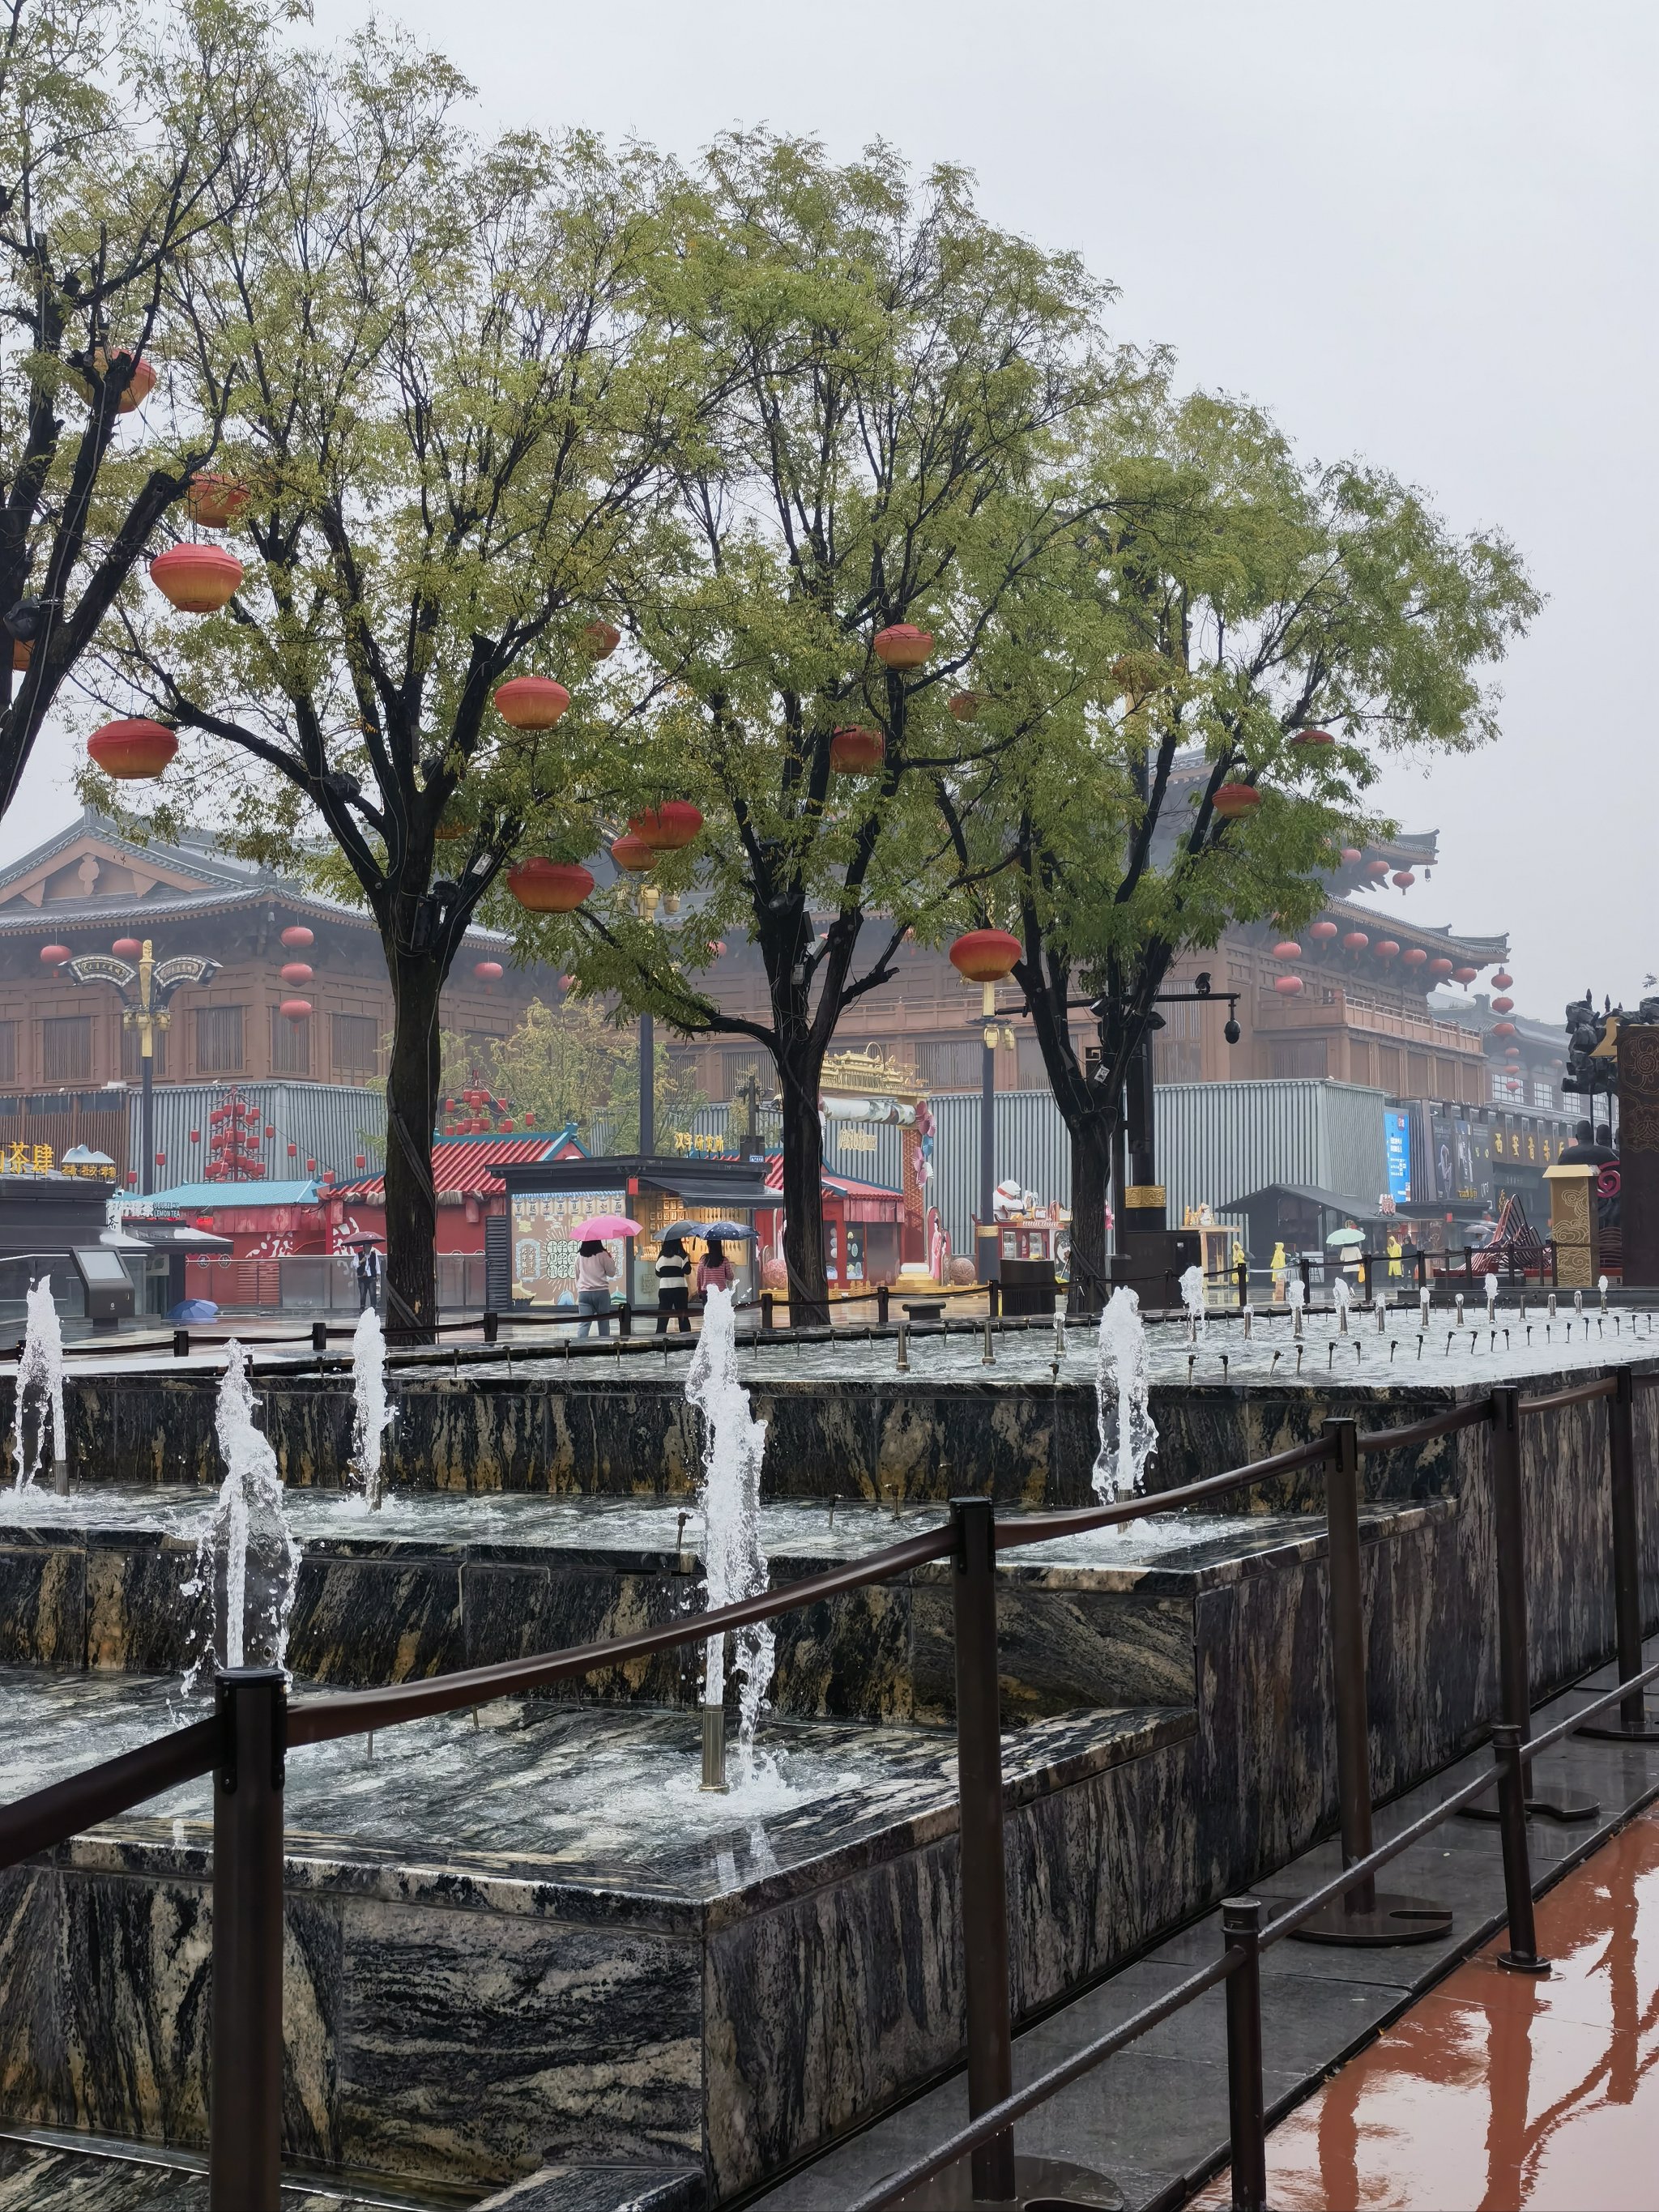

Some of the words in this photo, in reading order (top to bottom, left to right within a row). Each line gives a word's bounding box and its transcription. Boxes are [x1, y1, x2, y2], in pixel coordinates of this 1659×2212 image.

[674, 1132, 724, 1153] 汉字研究所
[0, 1141, 54, 1175] 茶肆
[154, 1209, 170, 1217] LEMON
